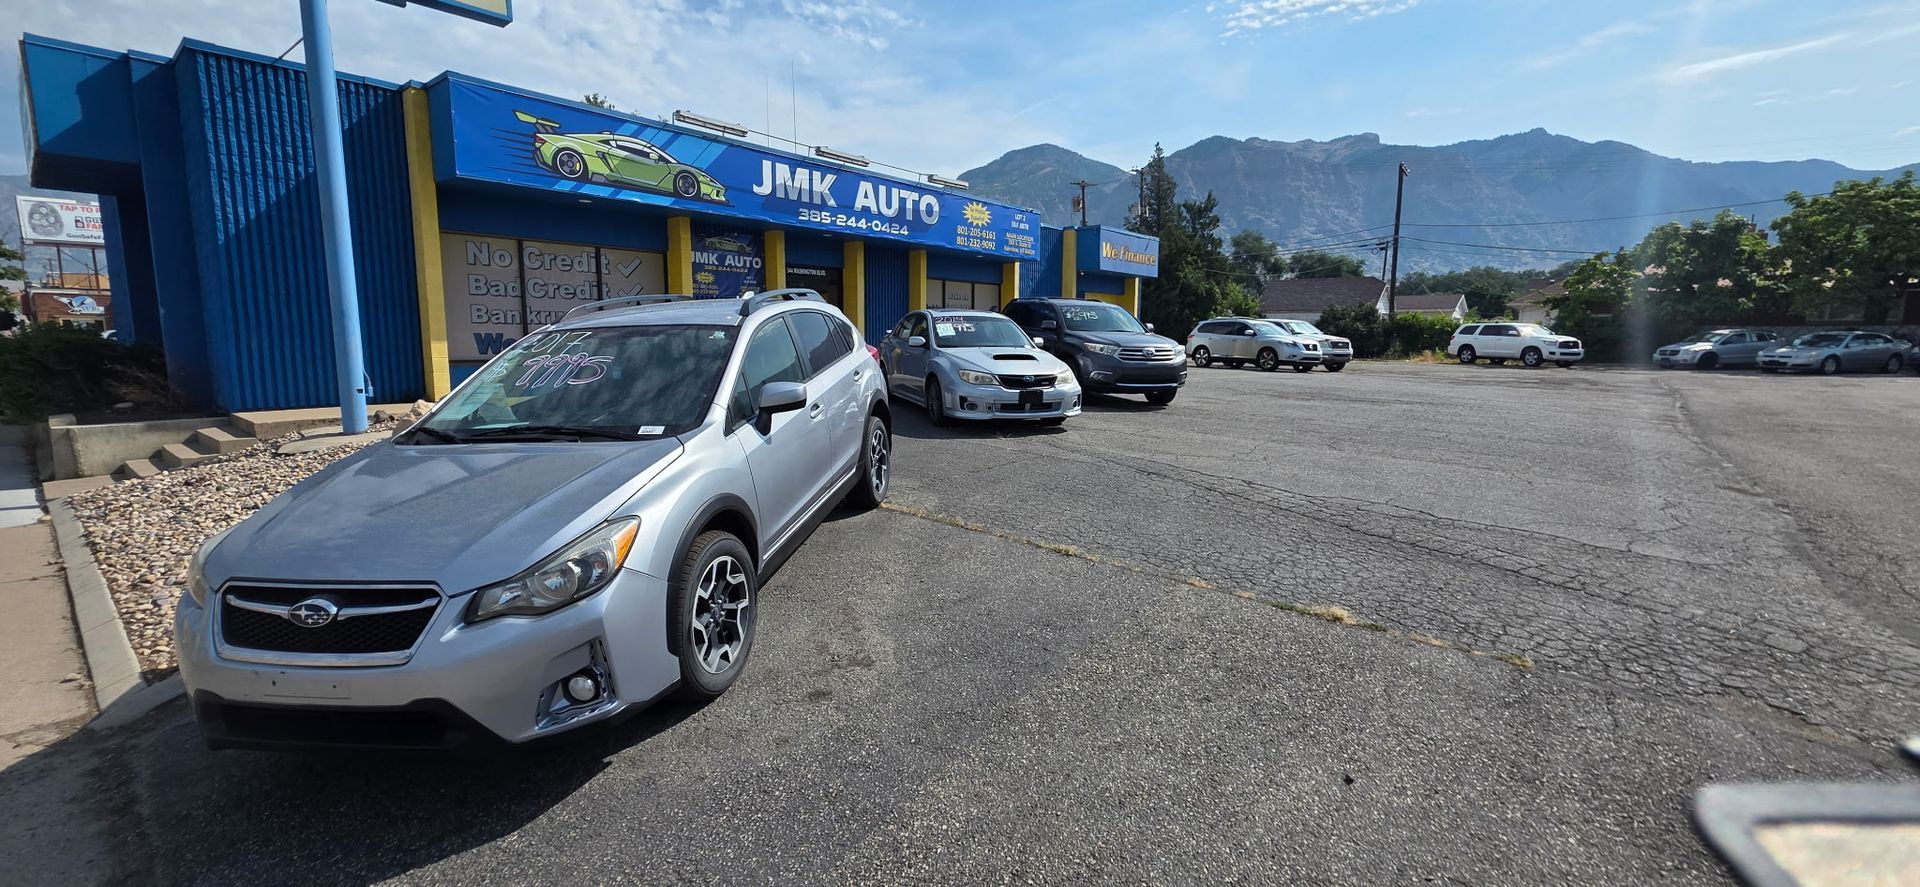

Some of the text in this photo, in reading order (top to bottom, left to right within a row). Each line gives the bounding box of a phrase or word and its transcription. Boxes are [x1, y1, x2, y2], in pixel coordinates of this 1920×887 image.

[753, 159, 940, 225] JMK AUTO
[60, 204, 78, 212] TAP
[798, 208, 909, 236] 385-244-0424
[957, 225, 996, 240] 801-205-6161
[956, 236, 996, 250] 801-232-9092
[1102, 241, 1156, 266] We Finance
[465, 240, 610, 275] No Credit
[725, 254, 762, 269] AUTO
[467, 274, 611, 301] Bad Credit
